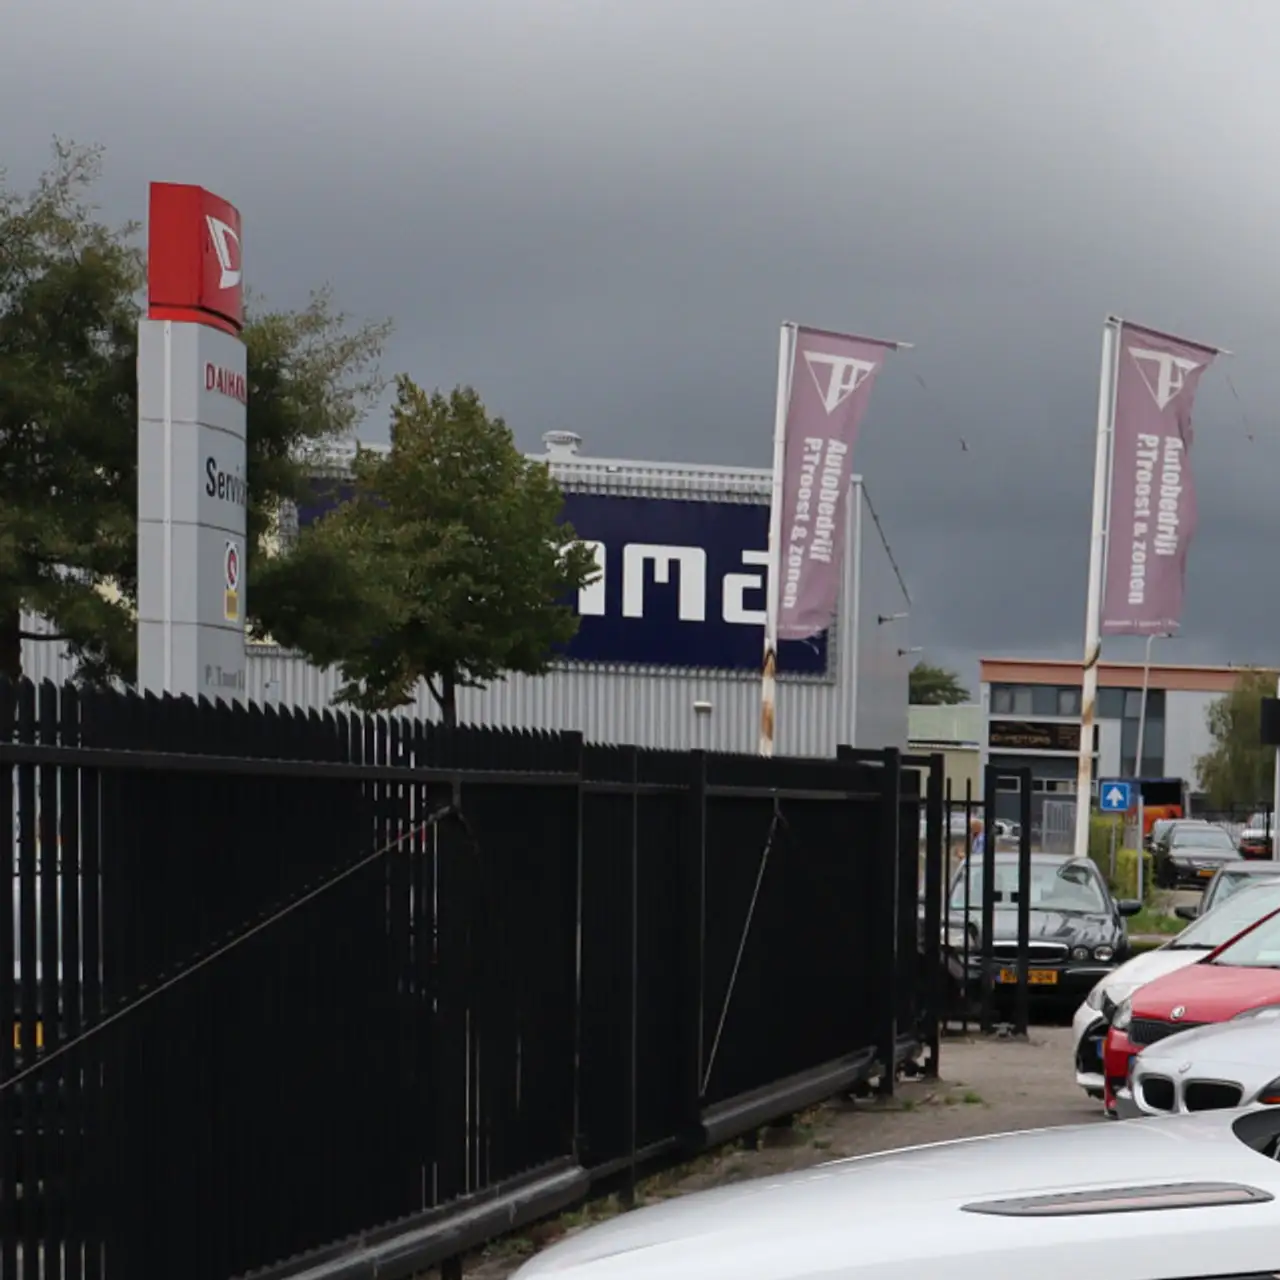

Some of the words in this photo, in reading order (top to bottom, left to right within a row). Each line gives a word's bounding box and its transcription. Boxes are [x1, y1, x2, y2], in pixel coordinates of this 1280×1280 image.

[809, 438, 848, 563] Autobedrijf
[1155, 435, 1184, 556] Autobedrijf
[782, 546, 805, 609] zonen
[1127, 541, 1147, 606] zonen
